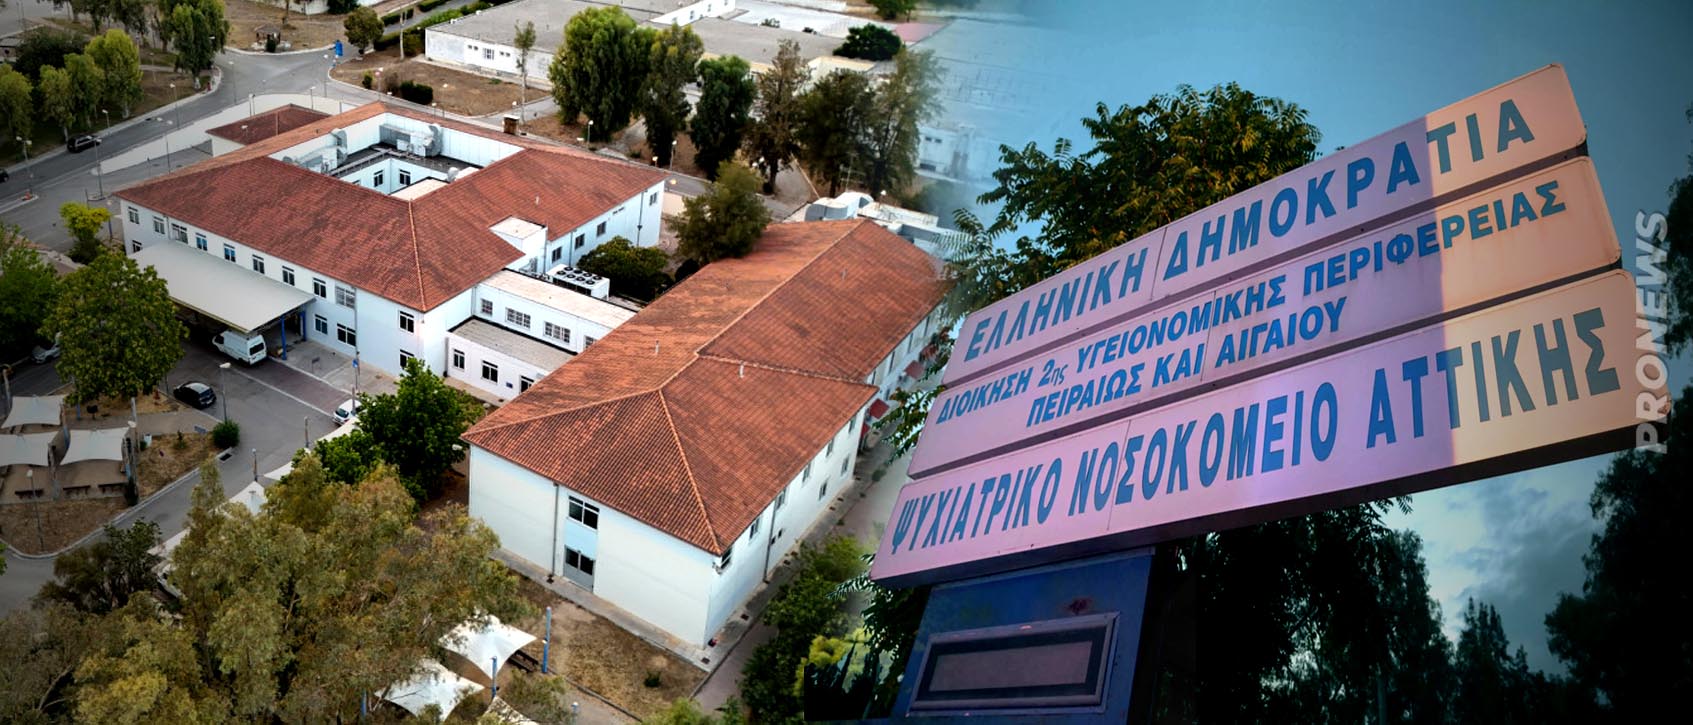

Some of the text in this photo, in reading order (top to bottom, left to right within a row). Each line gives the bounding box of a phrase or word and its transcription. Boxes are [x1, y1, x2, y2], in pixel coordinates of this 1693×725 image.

[936, 367, 1034, 424] ΔΙΟΙΚΗΣΗ
[1077, 275, 1287, 372] ΥΓΕΙΟΝΟΜΙΚΗΣ
[1303, 181, 1567, 296] ΠΕΡΙΦΕΡΕΙΑΣ
[965, 99, 1535, 362] ΕΛΛΗΝΙΚΗ ΔΗΜΟΚΡΑΤΙΑ
[892, 308, 1620, 555] ΨΥΧΙΑΤΡΙΚΟ ΝΟΣΟΚΟΜΕΙΟ ΑΤΤΙΚΗΣ
[1027, 297, 1348, 428] ΠΕΙΡΑΙΩΣ ΚΑΙ ΑΙΓΑΙΟΥ
